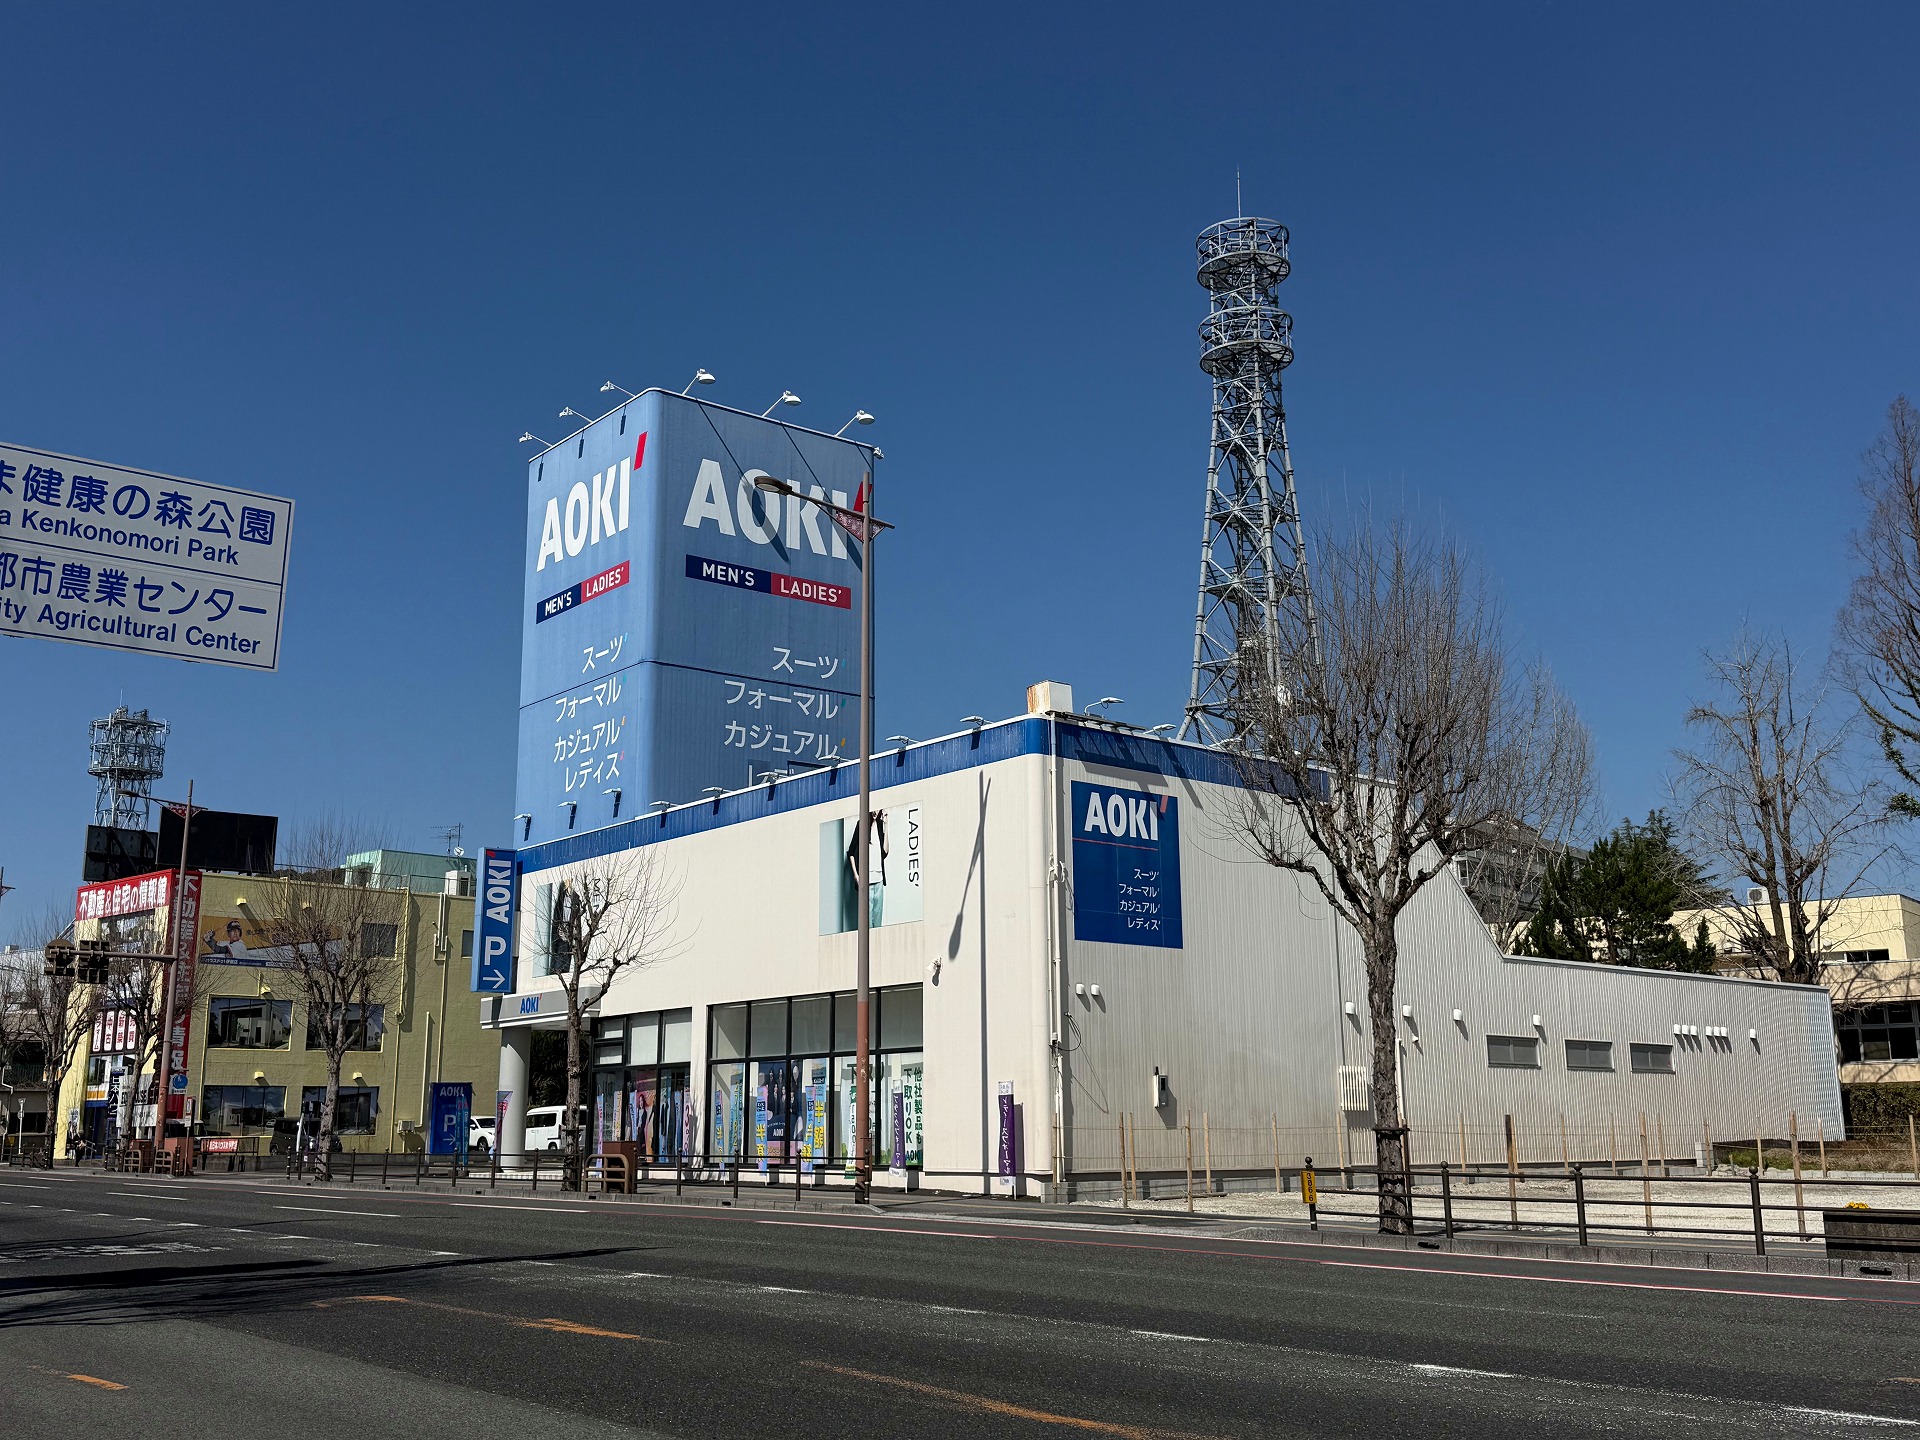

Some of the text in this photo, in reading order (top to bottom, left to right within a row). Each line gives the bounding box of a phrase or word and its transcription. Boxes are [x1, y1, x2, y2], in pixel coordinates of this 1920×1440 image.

[22, 508, 180, 555] Kenkonomori
[188, 538, 240, 566] Park
[544, 566, 625, 617] MEN'S LADIES'
[702, 561, 843, 604] MEN'S LADIES'
[37, 603, 176, 643] Agricultural
[186, 625, 261, 655] Center
[582, 634, 624, 674] スーツ
[772, 646, 840, 680] スーツ
[555, 676, 622, 723] フォーマル
[724, 679, 839, 720] フォーマル
[553, 719, 621, 764] カジュアル
[723, 719, 838, 760] カジュアル
[565, 752, 620, 793] レディス
[907, 807, 920, 888] LADIES'
[913, 1066, 923, 1145] 他社製品も
